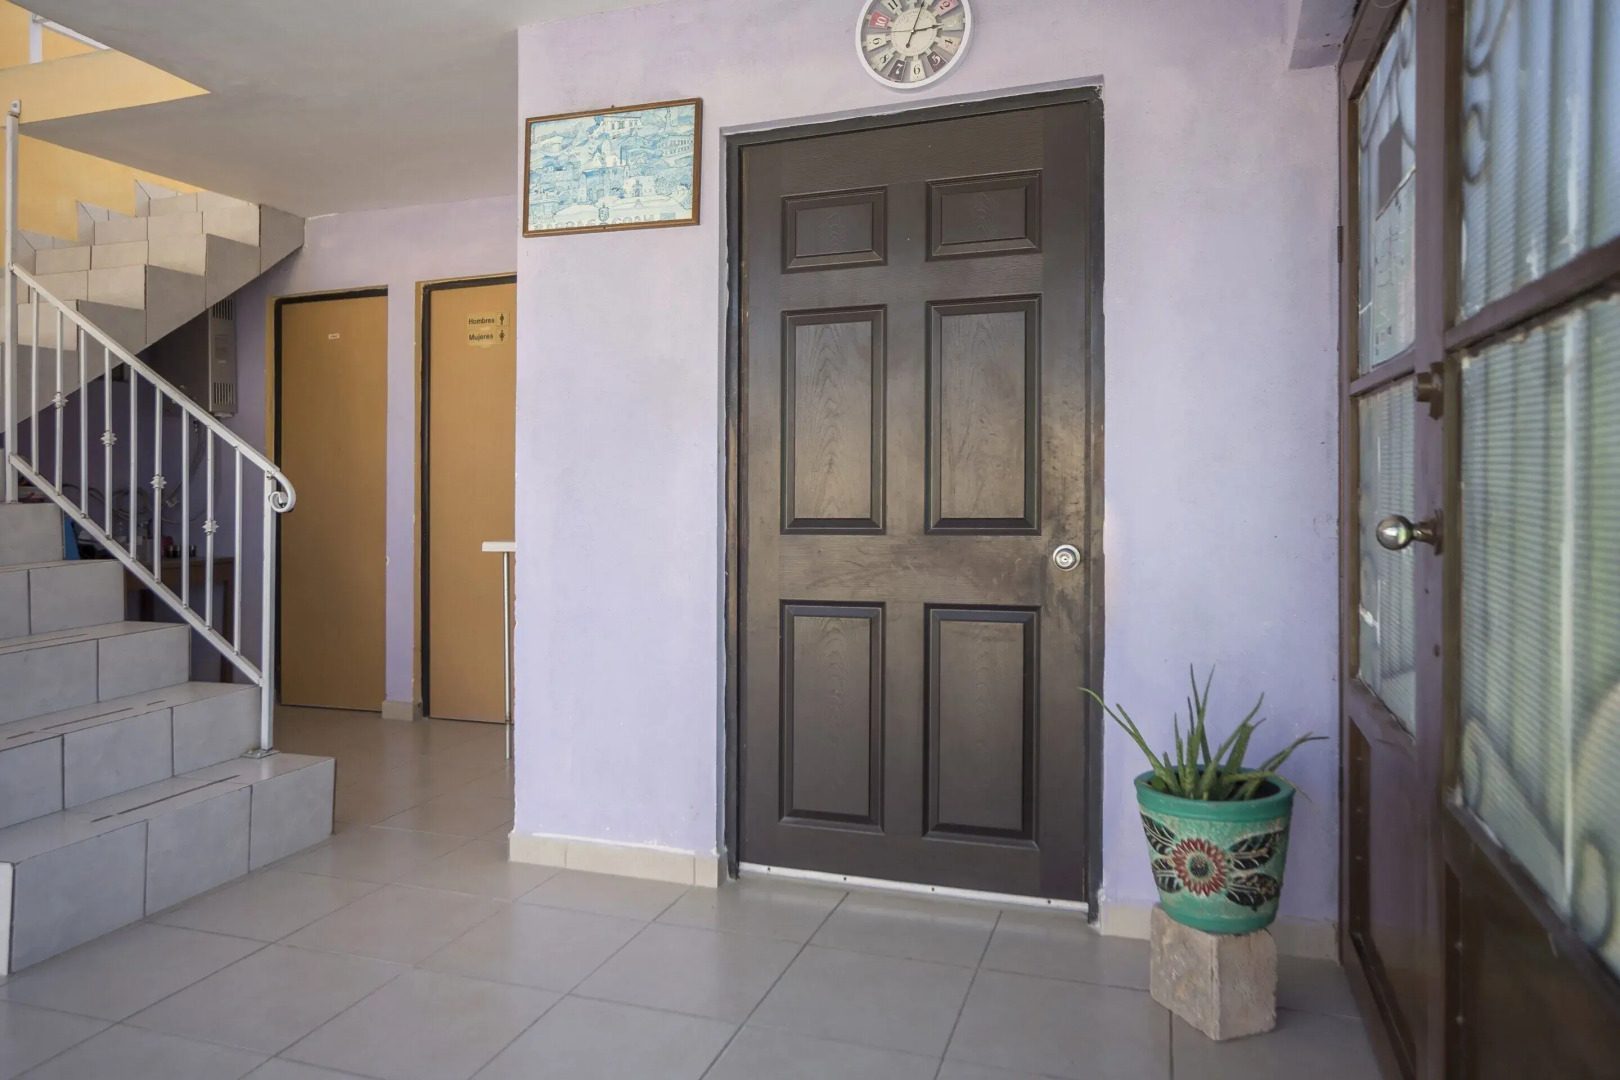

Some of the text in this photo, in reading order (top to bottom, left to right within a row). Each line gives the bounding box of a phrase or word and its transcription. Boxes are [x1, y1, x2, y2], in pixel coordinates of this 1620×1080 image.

[875, 16, 887, 27] 10
[872, 37, 882, 45] 9
[880, 53, 890, 64] 8
[931, 54, 941, 66] 5
[895, 64, 903, 74] 7
[913, 65, 921, 75] 6
[468, 317, 495, 325] Hombres
[469, 333, 494, 341] Mujeres
